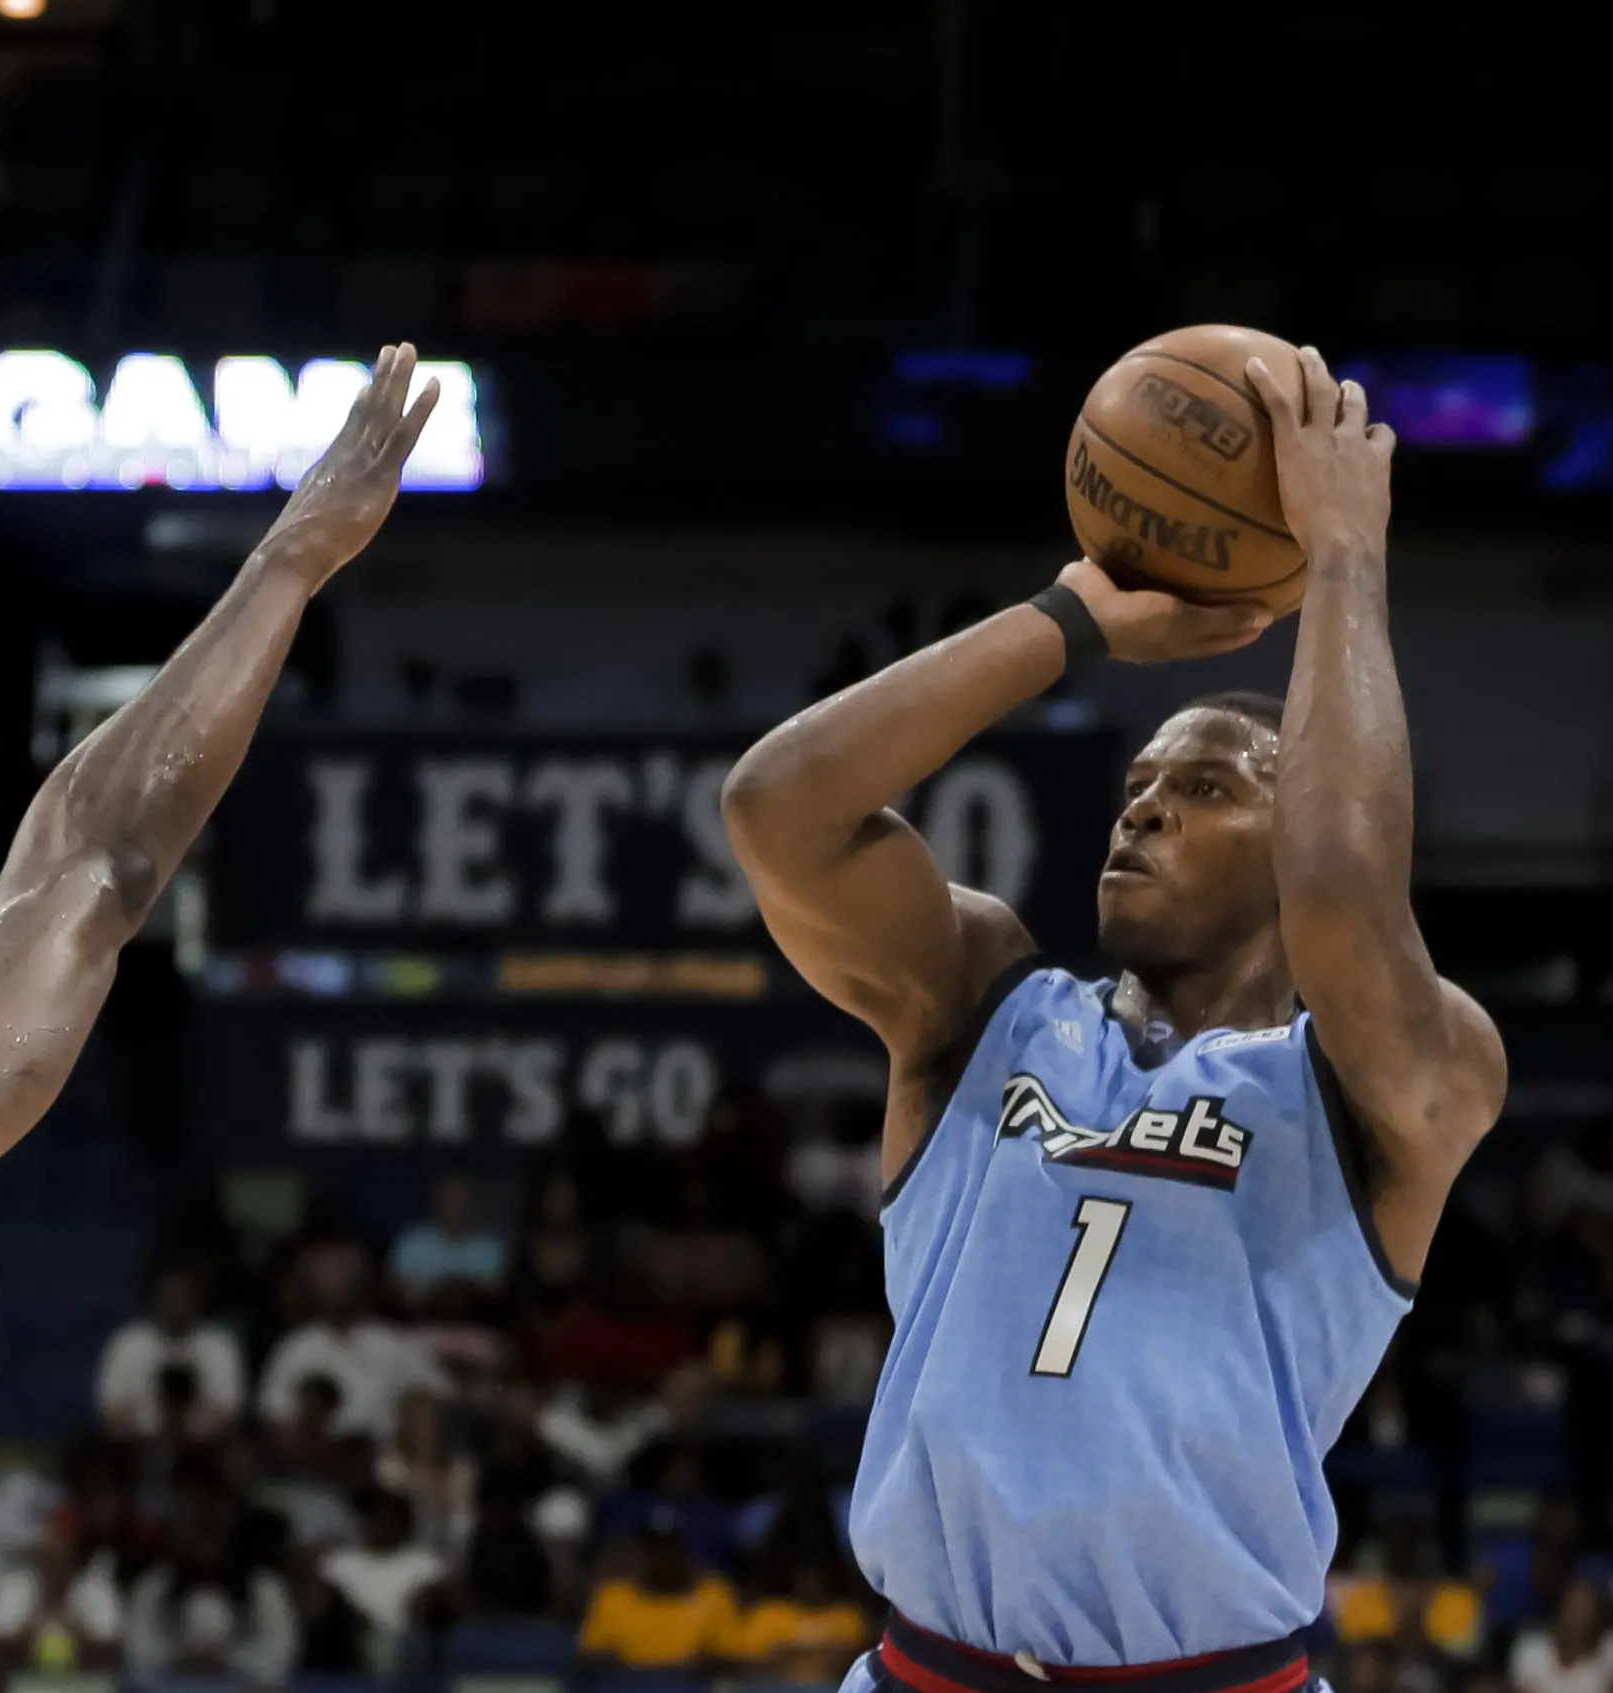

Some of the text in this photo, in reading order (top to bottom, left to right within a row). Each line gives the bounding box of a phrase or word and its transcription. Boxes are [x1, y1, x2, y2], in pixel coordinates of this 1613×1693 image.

[1069, 439, 1241, 572] SPALDING
[282, 1033, 569, 1146] LET'S
[1030, 1195, 1133, 1379] 1
